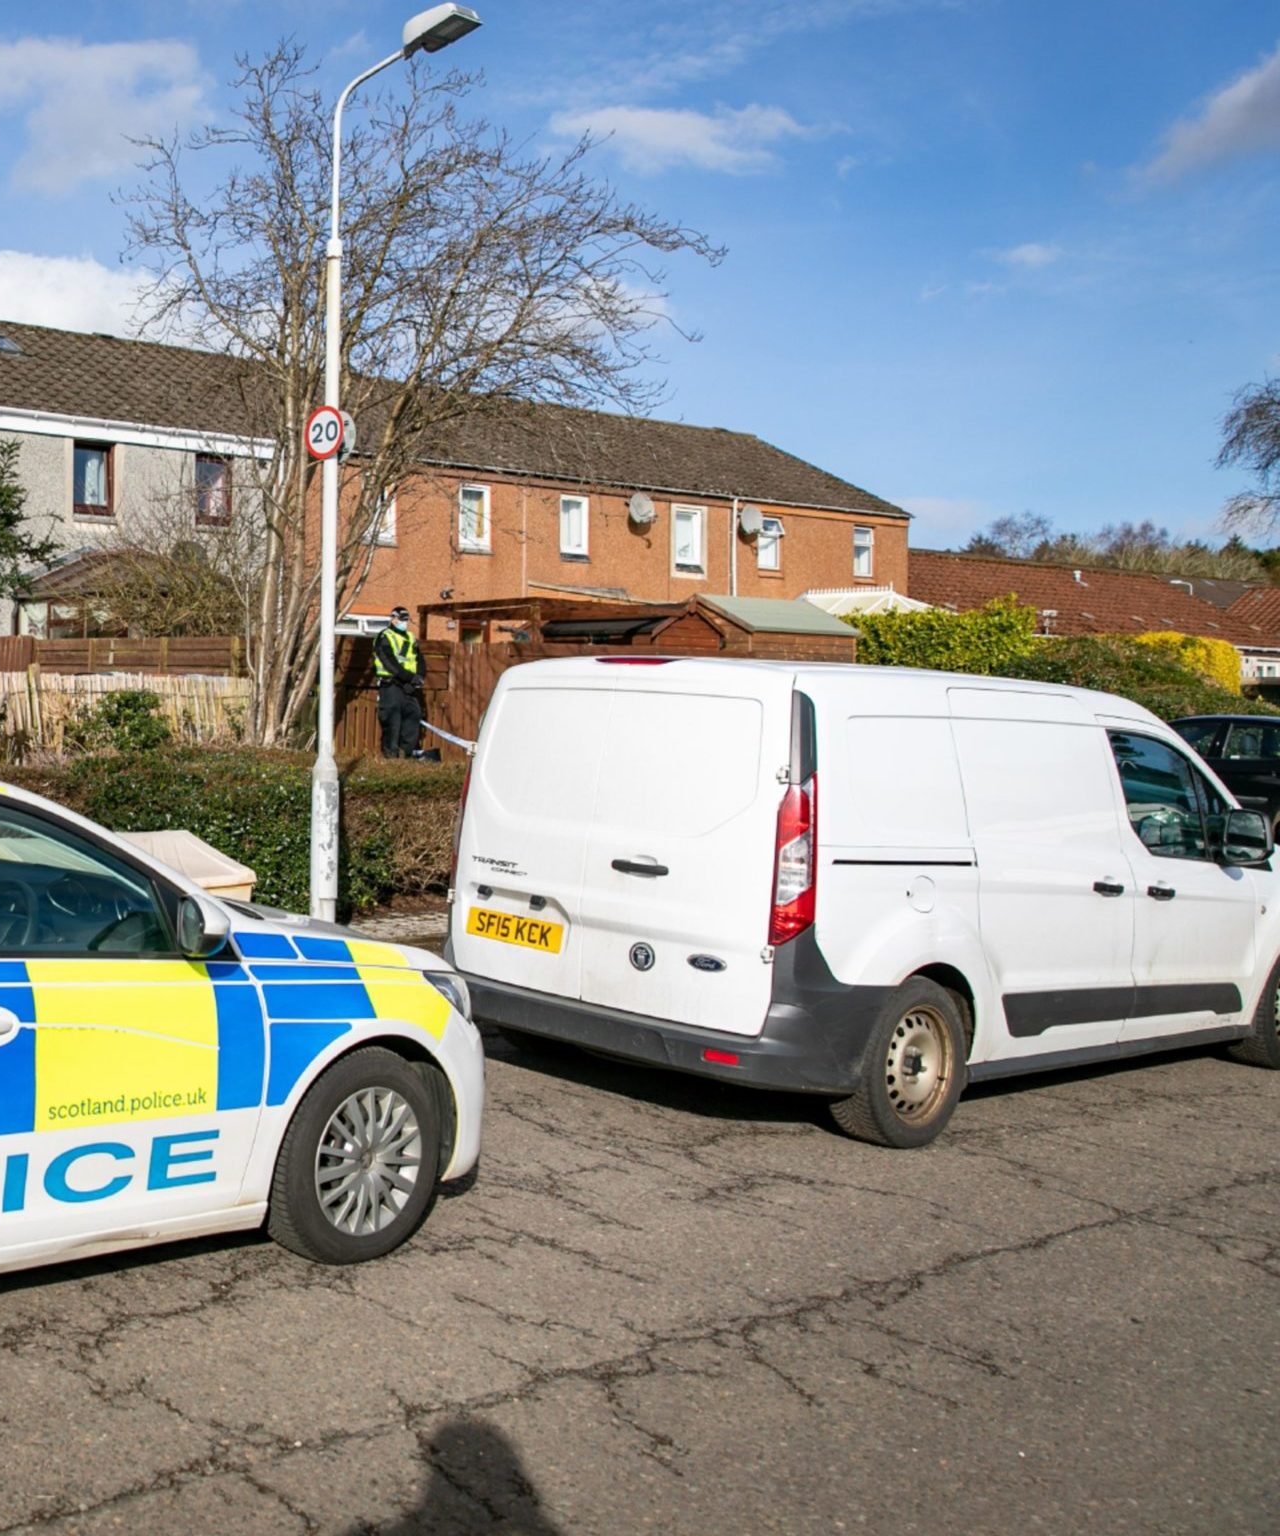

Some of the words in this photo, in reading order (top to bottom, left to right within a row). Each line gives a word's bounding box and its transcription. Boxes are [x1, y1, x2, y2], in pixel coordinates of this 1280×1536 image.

[312, 420, 338, 443] 20
[472, 855, 518, 868] TRANSIT
[476, 911, 512, 937] SF15
[514, 920, 552, 947] KCK
[48, 1087, 207, 1120] scotland.police.uk
